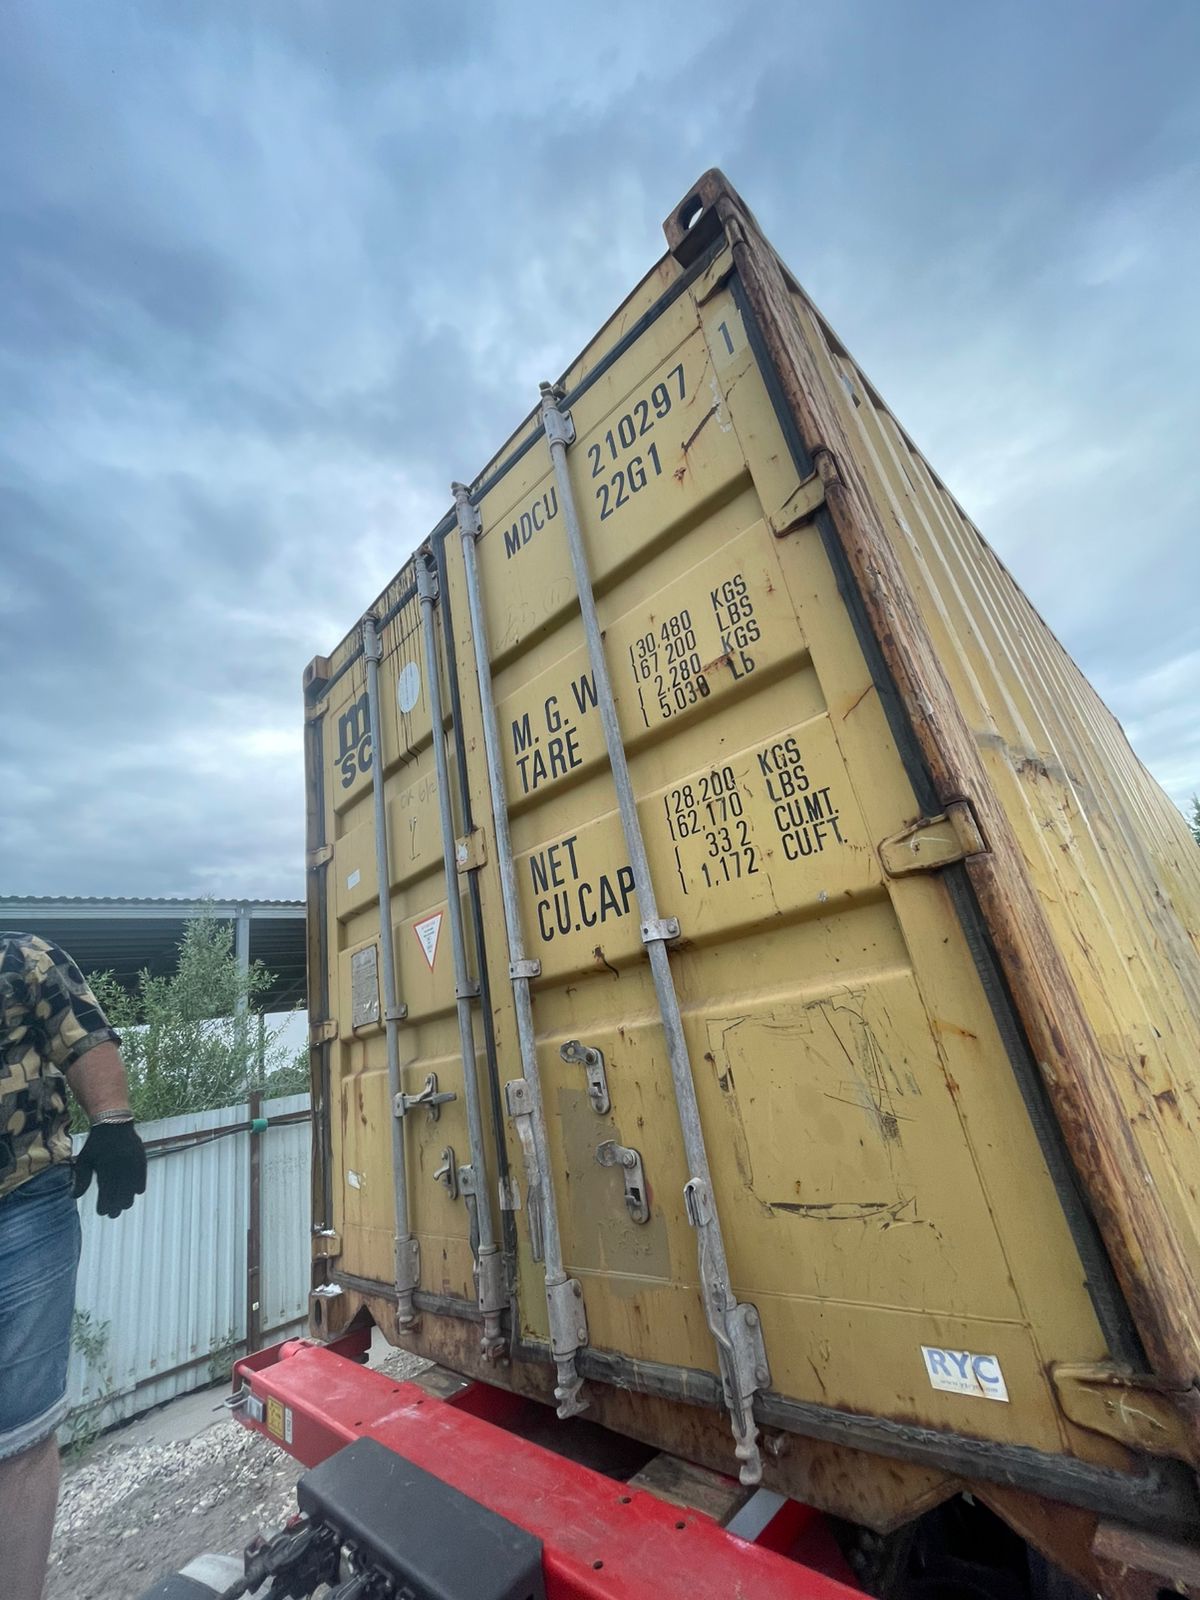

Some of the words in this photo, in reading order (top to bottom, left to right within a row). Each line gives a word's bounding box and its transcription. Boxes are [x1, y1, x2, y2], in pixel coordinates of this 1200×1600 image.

[503, 486, 558, 560] MDCU
[587, 363, 686, 479] 210297
[718, 321, 734, 355] 1
[595, 442, 662, 522] 22G1
[710, 574, 747, 611] KGS
[716, 595, 753, 633] LBS
[721, 619, 761, 656] KGS
[516, 727, 583, 794] TARE
[757, 738, 801, 776] KGS
[766, 765, 810, 803] LBS
[529, 836, 579, 895] NET
[537, 866, 636, 942] CU.CAP
[927, 1349, 1000, 1384] RYC
